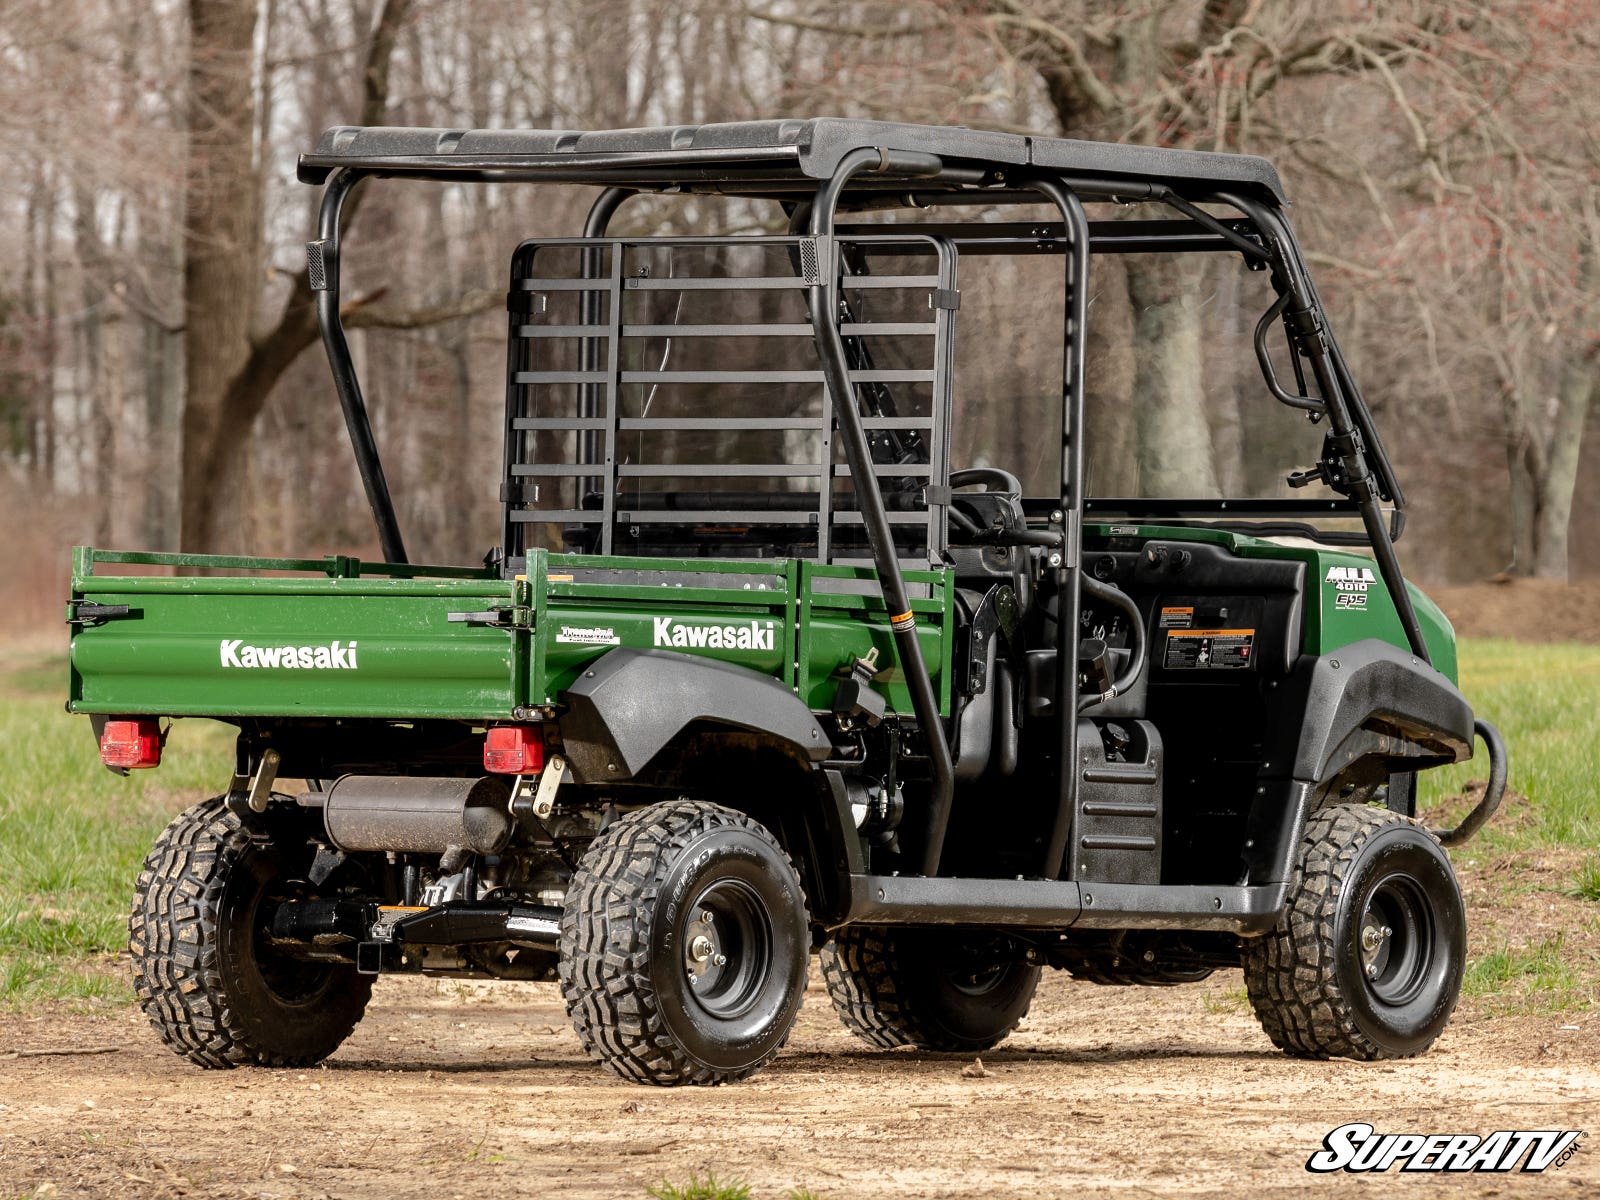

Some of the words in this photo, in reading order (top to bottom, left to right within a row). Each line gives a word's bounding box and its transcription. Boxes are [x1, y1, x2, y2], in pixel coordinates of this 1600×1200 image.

[1335, 583, 1368, 591] 4010
[653, 616, 774, 650] Kawasaki
[220, 639, 358, 669] Kawasaki
